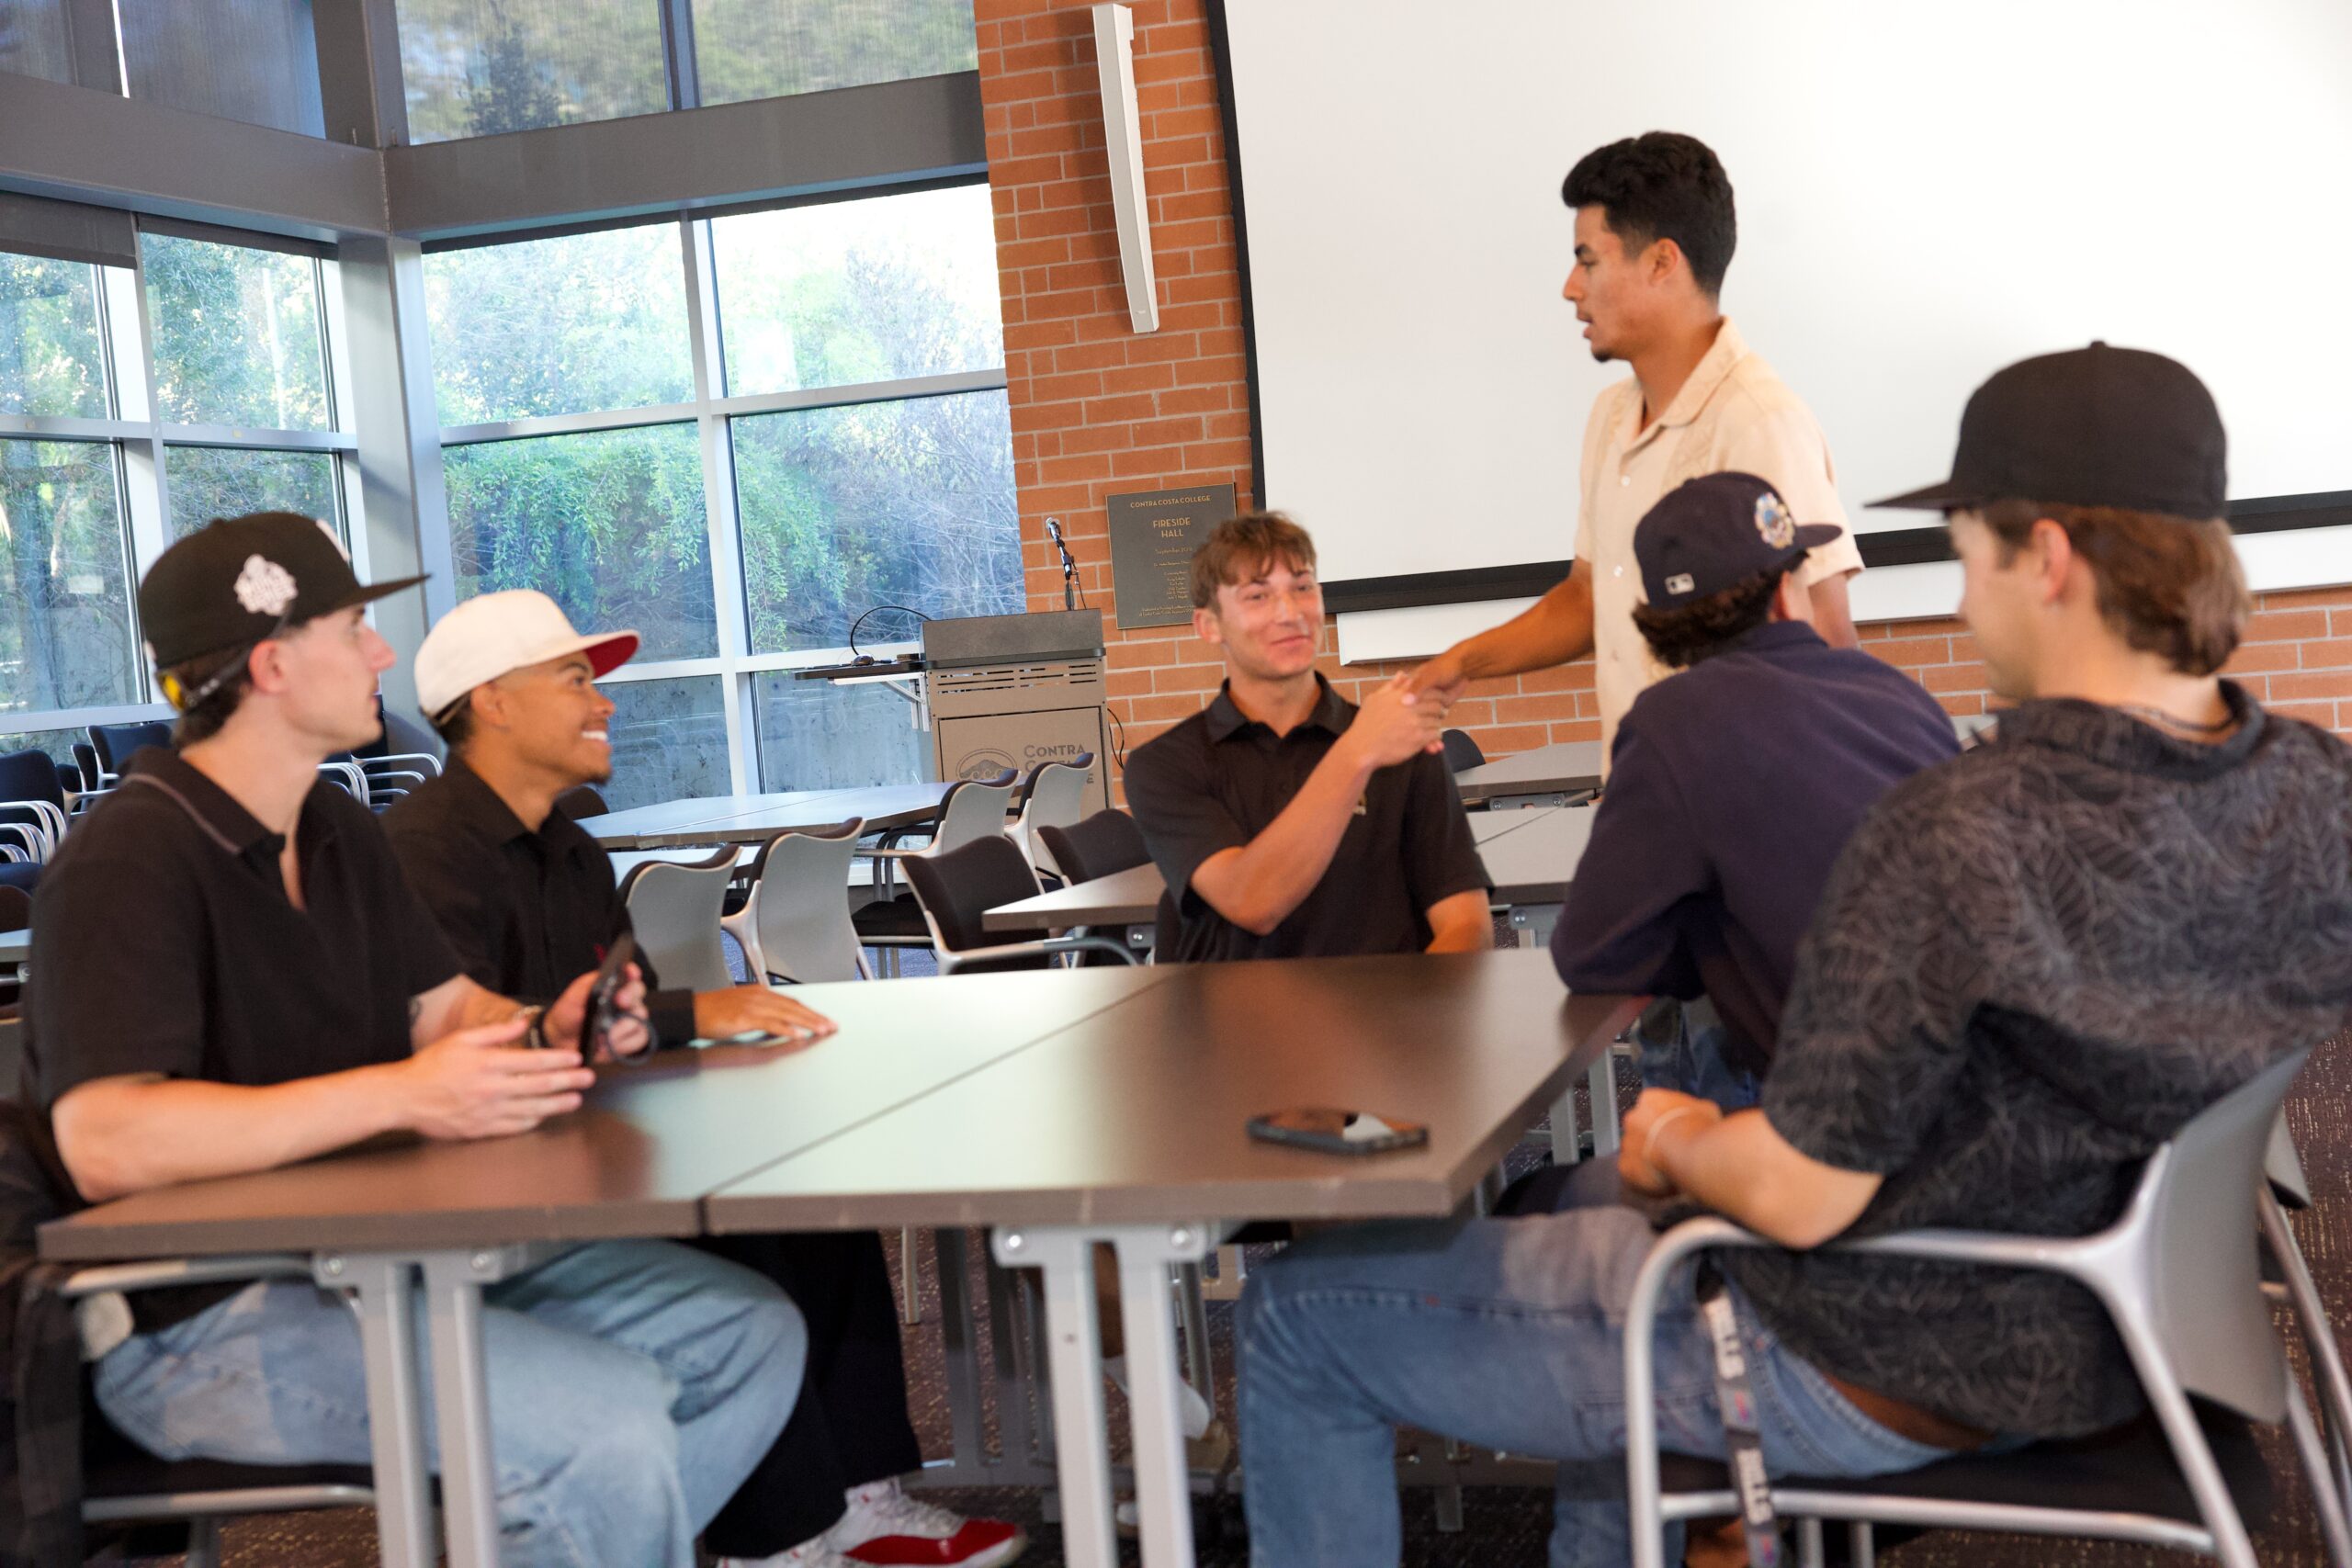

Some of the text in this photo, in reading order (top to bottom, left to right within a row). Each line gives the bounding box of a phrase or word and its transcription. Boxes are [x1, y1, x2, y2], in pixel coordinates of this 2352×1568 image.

[1180, 495, 1211, 503] COLLEGE
[1153, 517, 1192, 528] FIRESIDE
[1161, 529, 1183, 538] HALL
